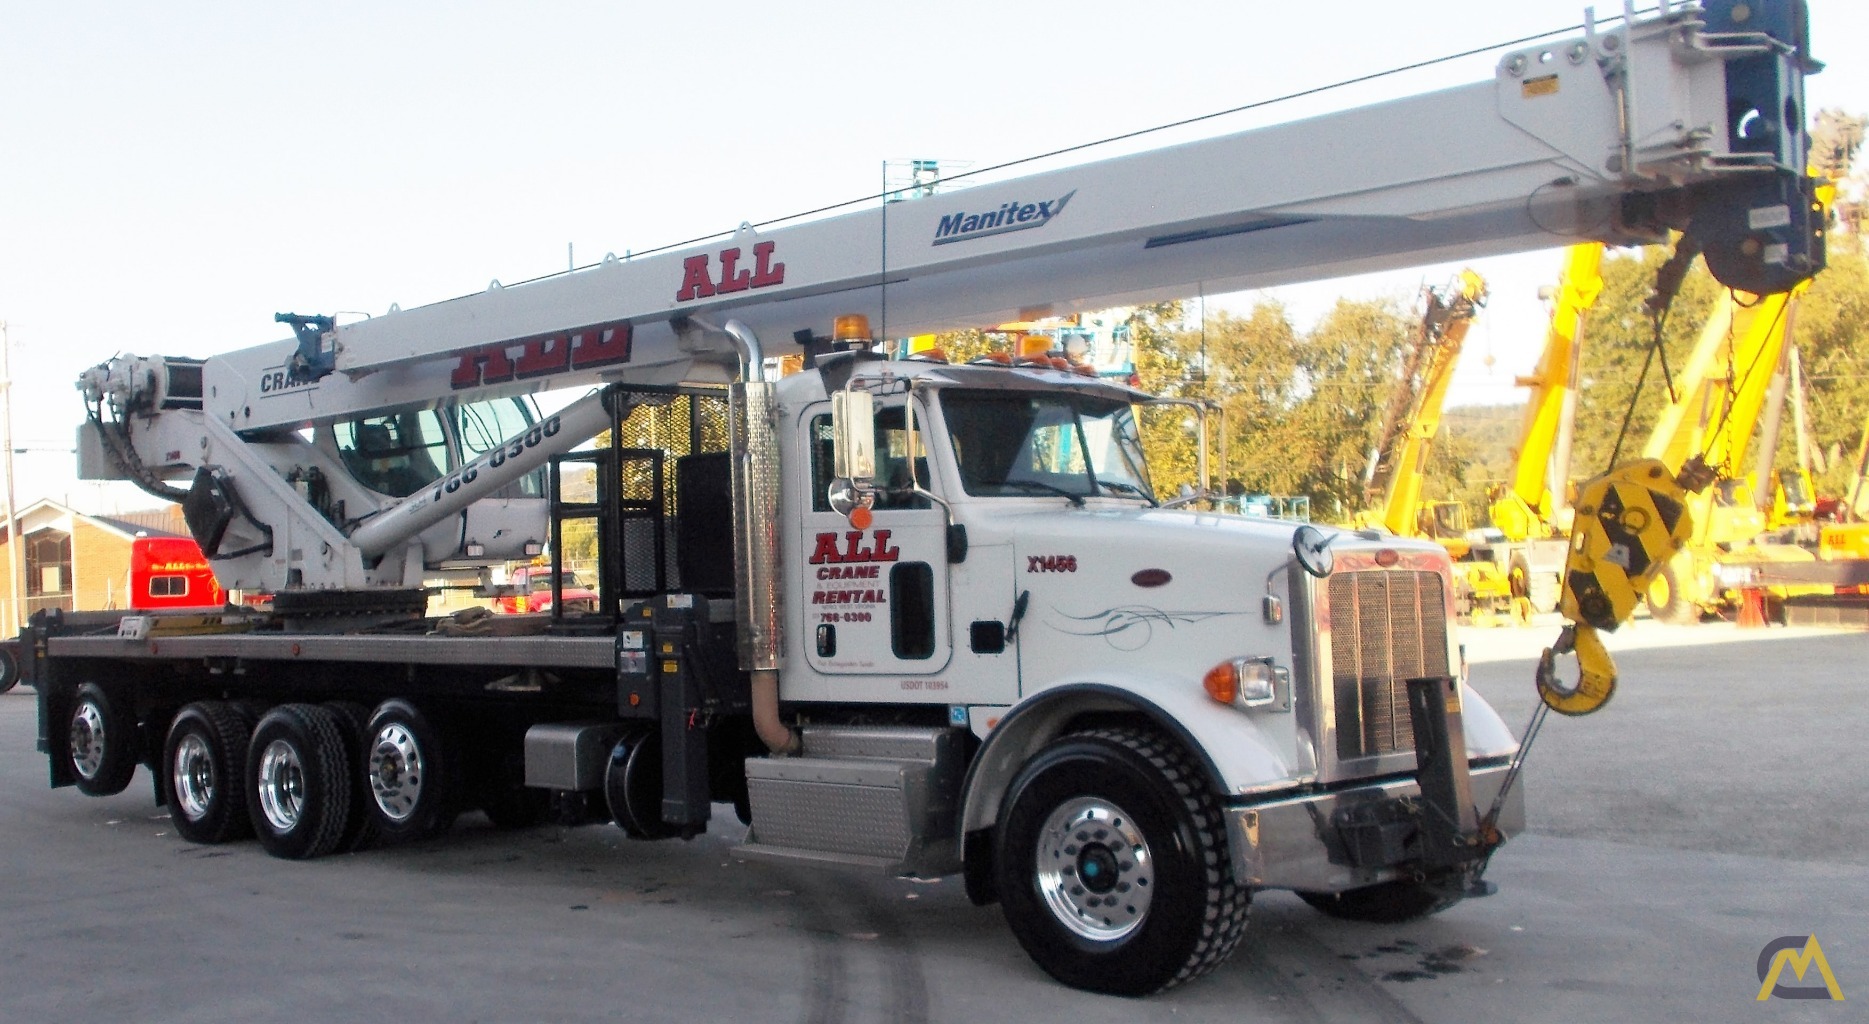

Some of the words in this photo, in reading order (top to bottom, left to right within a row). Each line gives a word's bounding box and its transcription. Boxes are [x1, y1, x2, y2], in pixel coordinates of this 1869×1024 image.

[935, 199, 1056, 238] Manitex
[676, 240, 786, 302] ALL
[261, 370, 317, 394] CRA
[433, 415, 562, 502] 766-0300
[808, 529, 900, 564] ALL
[816, 565, 880, 580] CRANE
[812, 589, 887, 604] RENTAL
[900, 680, 923, 690] USDOT
